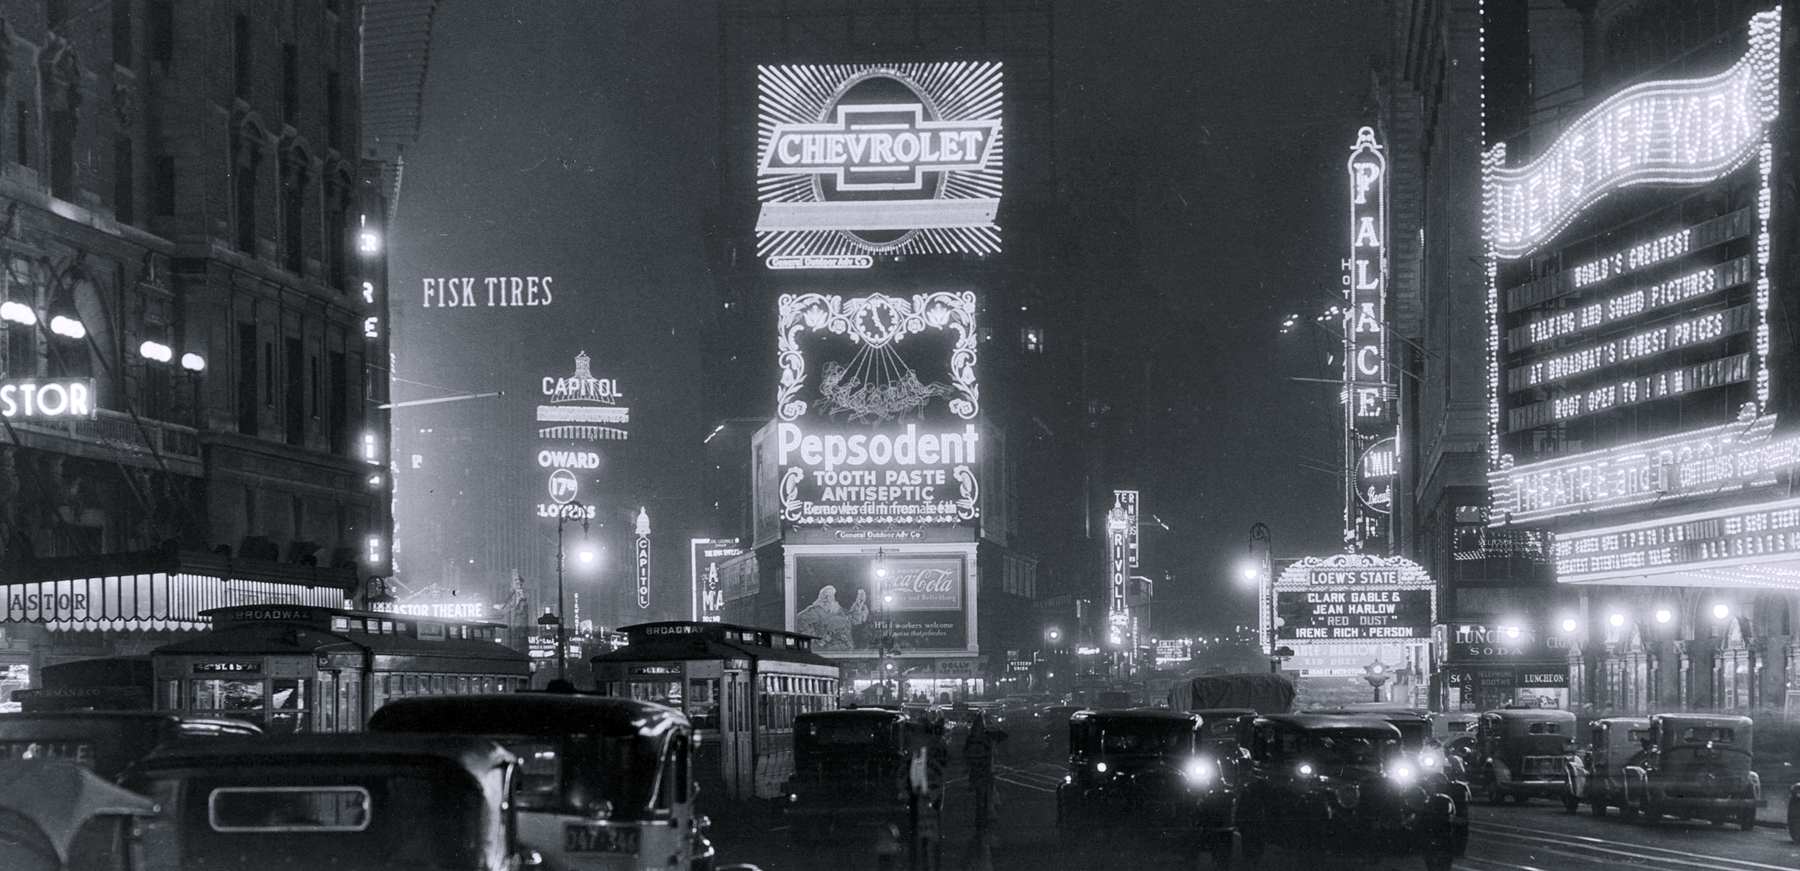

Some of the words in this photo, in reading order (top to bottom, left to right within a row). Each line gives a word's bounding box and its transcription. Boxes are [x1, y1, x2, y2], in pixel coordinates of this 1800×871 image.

[1598, 97, 1656, 182] NEW
[1664, 63, 1753, 166] YORK
[777, 130, 984, 165] CHEVROLET
[1574, 252, 1623, 288] WORLD'S
[1629, 229, 1691, 270] GREATEST
[423, 277, 476, 307] FISK
[484, 276, 553, 306] TIRES
[1354, 161, 1381, 417] PALACE
[1530, 311, 1575, 343] TALKING
[1581, 304, 1601, 328] AND
[1609, 290, 1644, 319] SOUND
[1651, 268, 1714, 308] PICTURES
[1530, 363, 1543, 384] AT
[1548, 343, 1616, 379] BROADWAY'S
[1623, 329, 1667, 360] LOWEST
[1674, 313, 1722, 346] PRICES
[542, 377, 622, 397] CAPITOL
[1588, 385, 1615, 411] OPEN
[1623, 380, 1637, 402] TO
[778, 423, 979, 471] Pepsodent
[538, 450, 600, 469] OWARD
[813, 470, 877, 485] TOOTH
[886, 469, 946, 484] PASTE
[821, 486, 935, 501] ANTISEPTIC
[1514, 463, 1608, 512] THEATRE
[1737, 533, 1785, 555] SEATS
[640, 540, 649, 605] CAPITOL
[1114, 533, 1123, 611] RIVOLI
[1311, 572, 1356, 584] LOEW'S
[1360, 571, 1396, 584] STATE
[10, 593, 86, 611] ASTOR
[1308, 592, 1345, 603] CLARK
[1351, 592, 1388, 602] GABLE
[1392, 591, 1401, 602] &
[392, 604, 429, 617] ASTOR
[432, 603, 482, 617] THEATRE
[1313, 604, 1343, 614] JEAN
[1349, 603, 1395, 614] HARLOW
[646, 626, 704, 635] BROADWAY
[895, 621, 922, 629] workers
[925, 621, 954, 629] welcome
[1296, 628, 1328, 638] IRENE
[1333, 628, 1359, 638] RICH
[1369, 627, 1413, 637] PERSON
[1330, 645, 1377, 657] HARLOW
[1470, 647, 1524, 656] SODA
[1304, 658, 1324, 666] RED
[1330, 658, 1357, 666] DUST
[1481, 678, 1511, 686] BOOTHS
[1524, 674, 1564, 683] LUNCHEON
